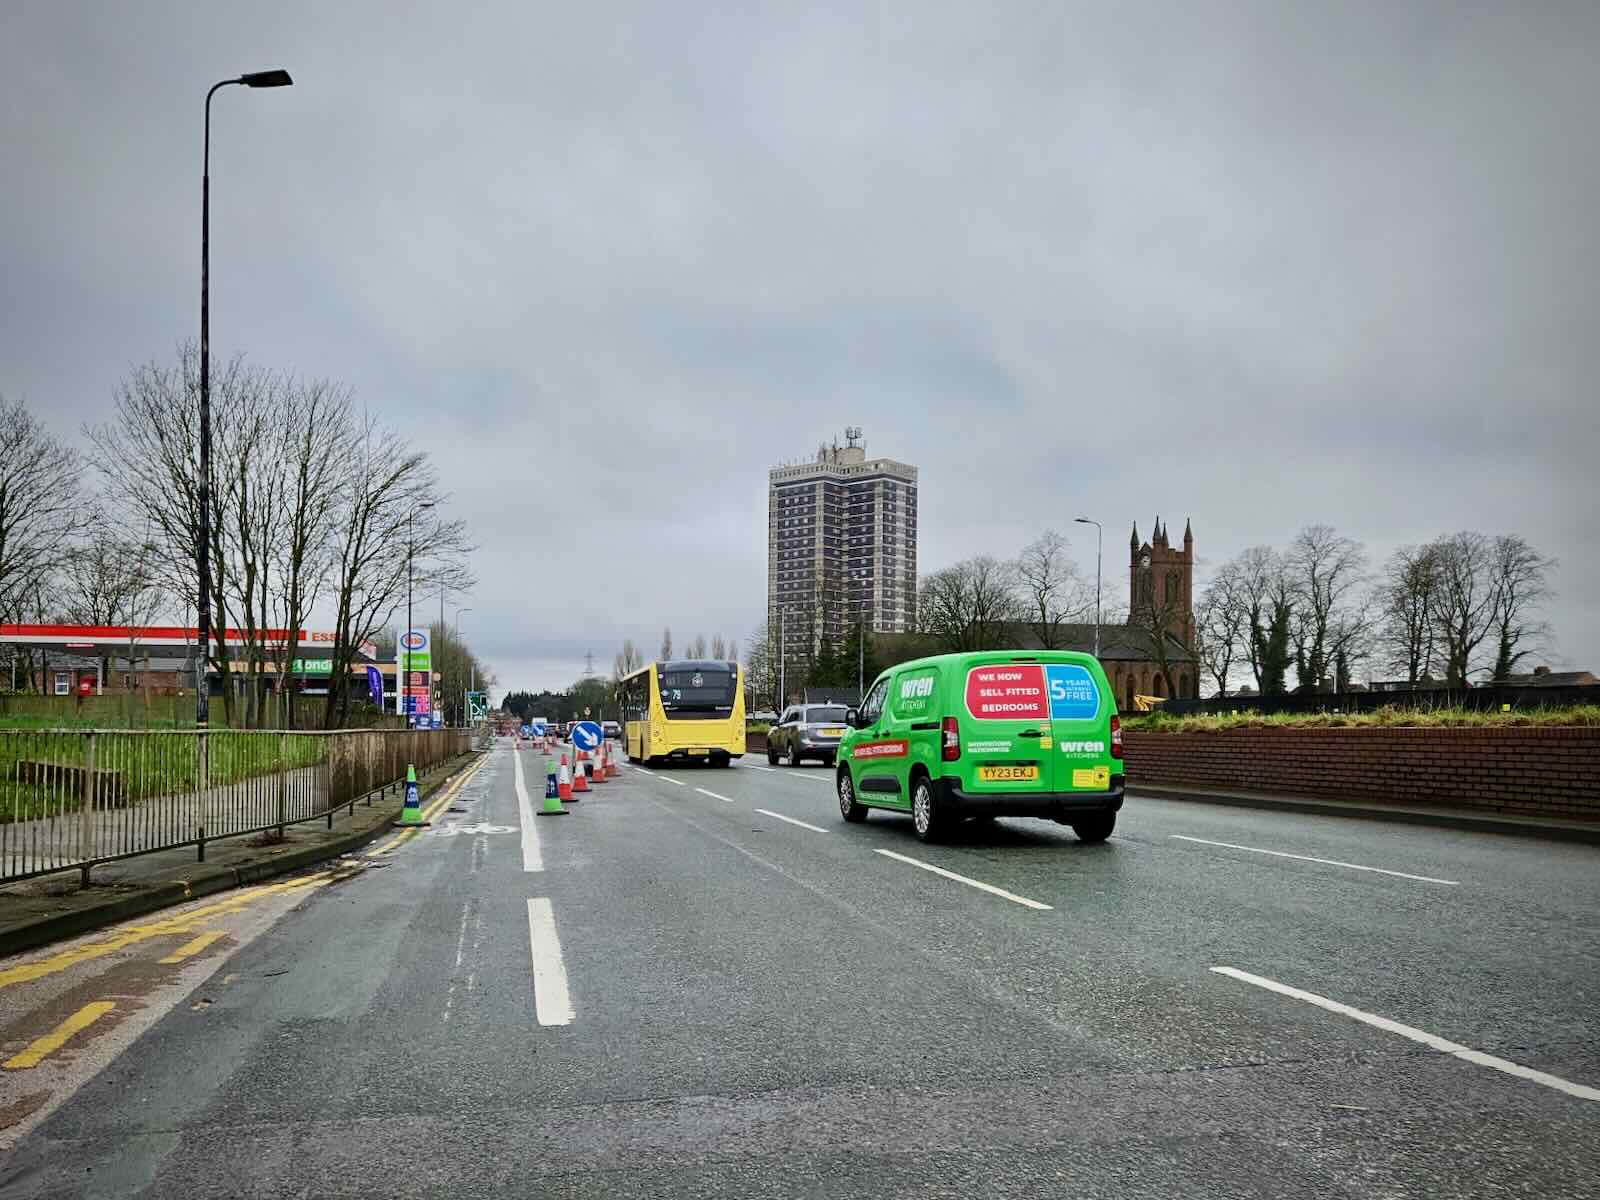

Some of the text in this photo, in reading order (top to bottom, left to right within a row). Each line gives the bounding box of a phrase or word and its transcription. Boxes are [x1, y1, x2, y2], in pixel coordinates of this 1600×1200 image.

[312, 632, 338, 641] ESS
[297, 658, 333, 671] Londi
[978, 672, 1023, 681] WE NOW
[901, 677, 934, 698] wren
[980, 687, 1040, 697] SELL FITTED
[1051, 679, 1066, 700] 5
[672, 689, 681, 700] 79
[1067, 691, 1093, 701] FREE
[981, 703, 1039, 713] BEDROOMS
[1060, 741, 1105, 752] wren
[983, 767, 1034, 778] YY23 EKJ
